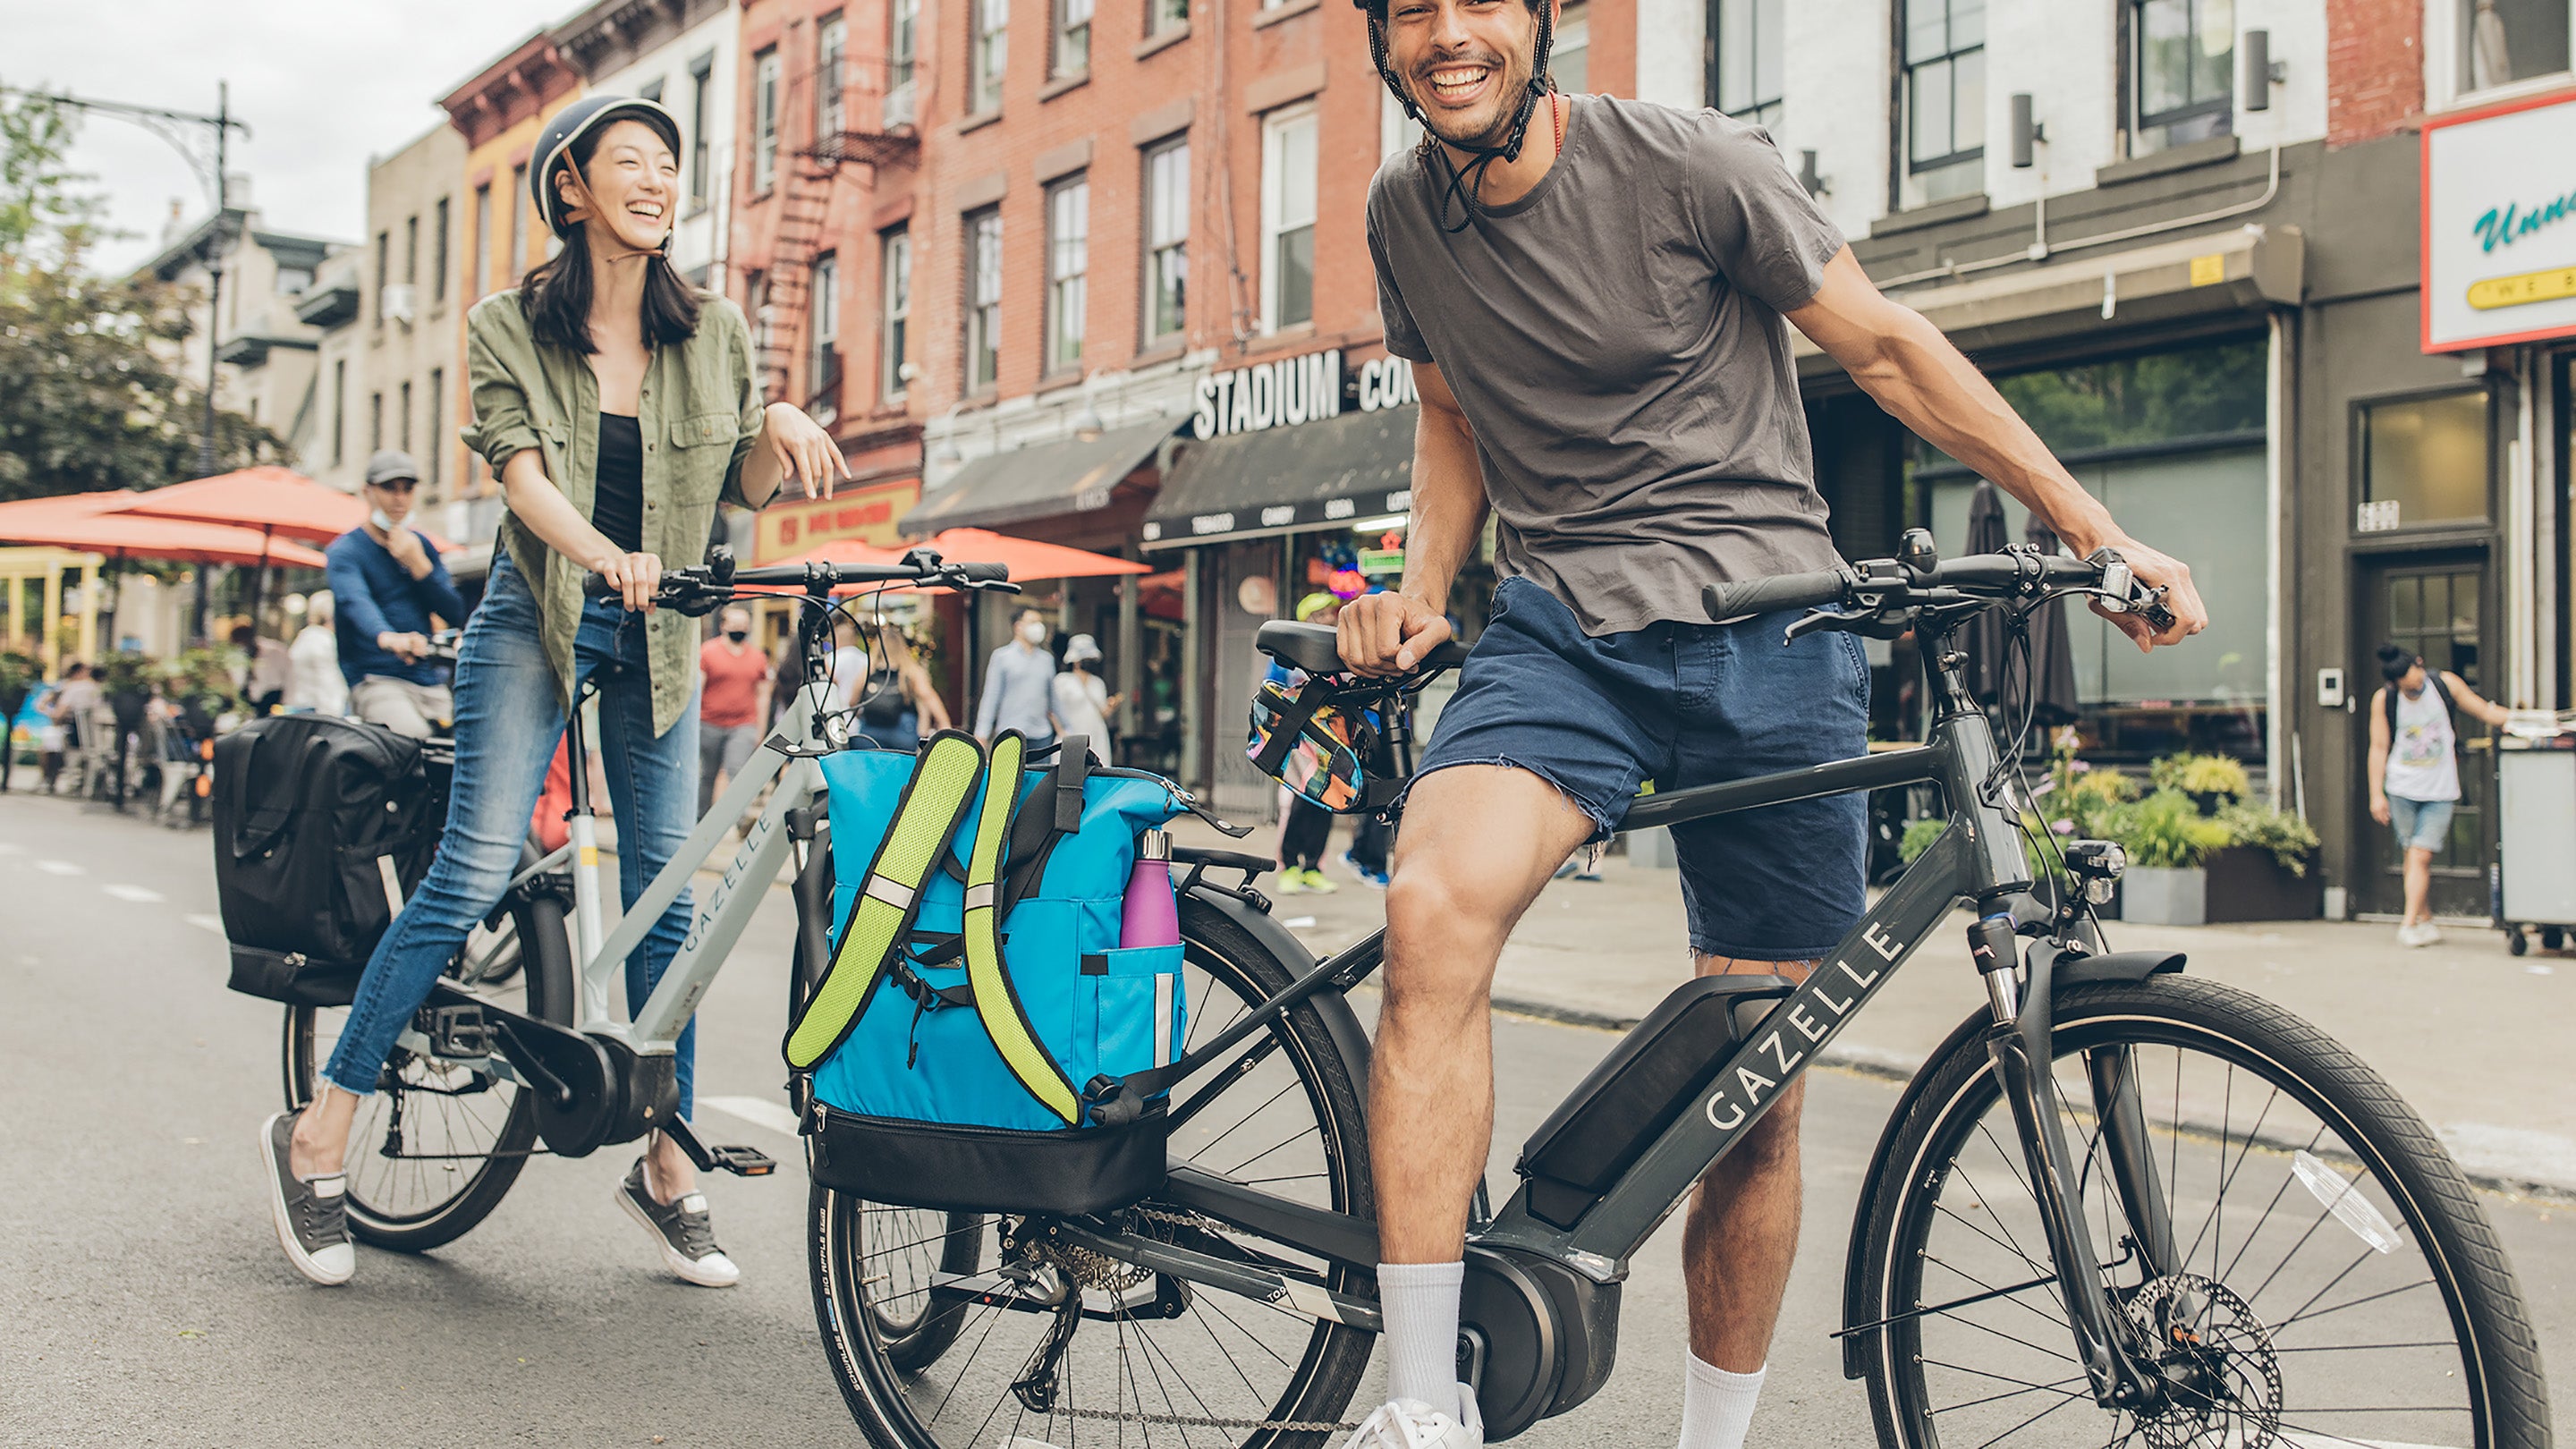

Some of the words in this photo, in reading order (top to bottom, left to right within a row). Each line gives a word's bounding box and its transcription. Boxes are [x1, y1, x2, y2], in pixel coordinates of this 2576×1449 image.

[1193, 349, 1341, 441] STADIUM
[685, 811, 771, 953] GAZELLE
[1706, 921, 1904, 1131] GAZELLE
[819, 1236, 828, 1273] APPLE
[822, 1276, 831, 1295] BIG
[835, 1335, 861, 1392] SCHWALBE
